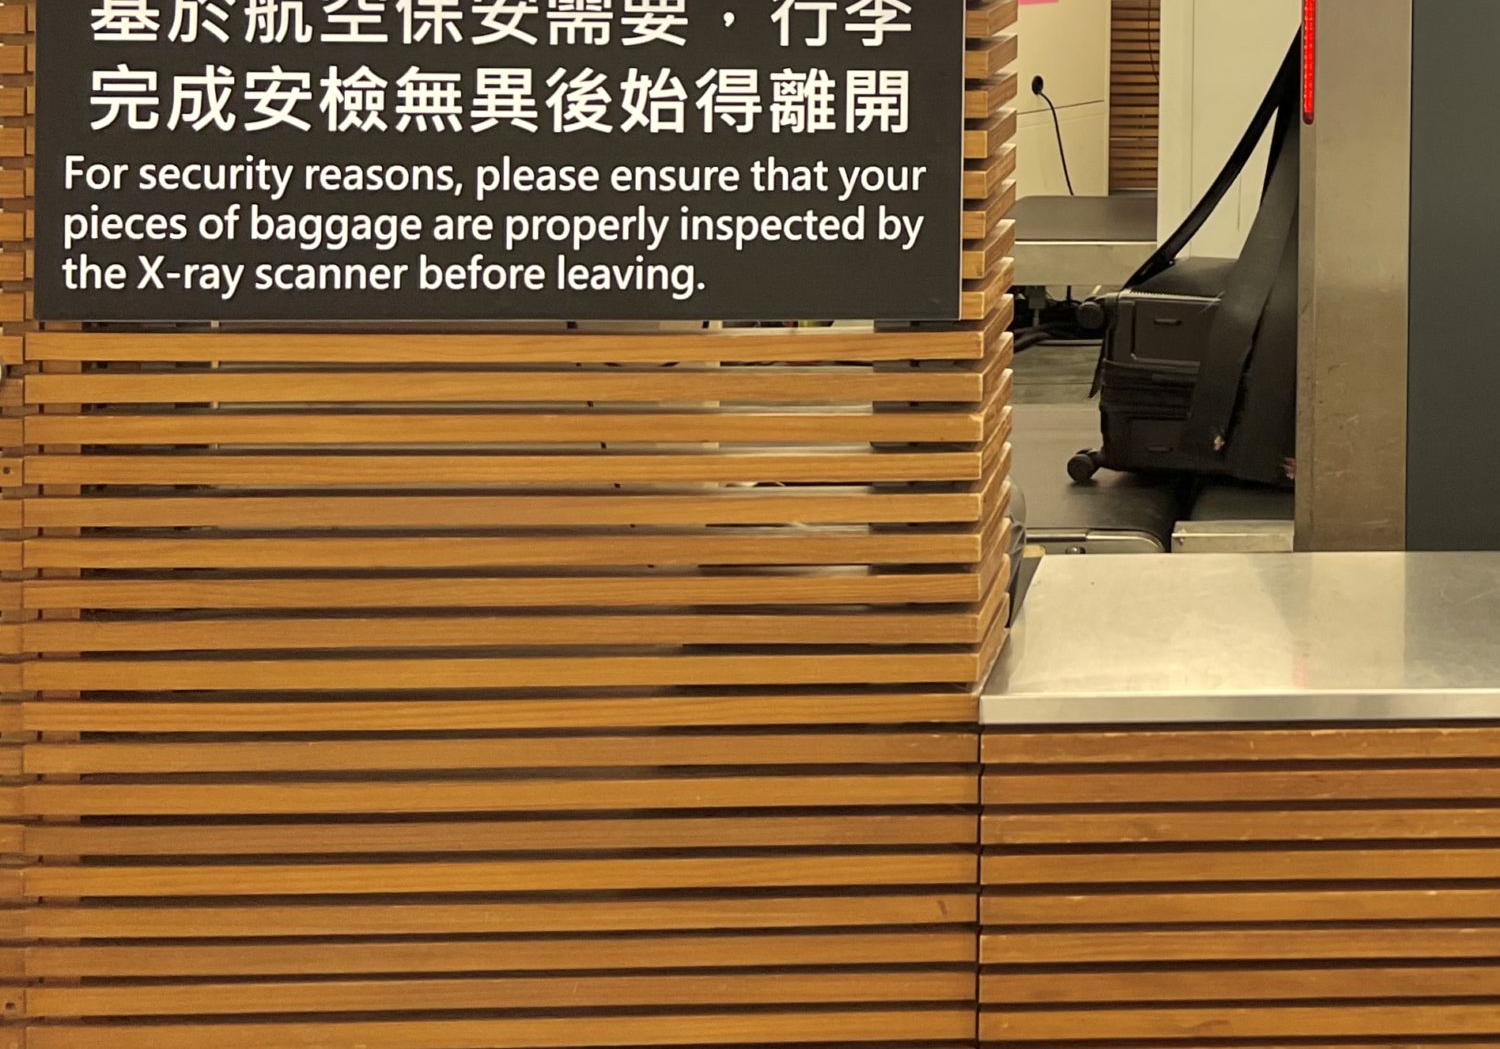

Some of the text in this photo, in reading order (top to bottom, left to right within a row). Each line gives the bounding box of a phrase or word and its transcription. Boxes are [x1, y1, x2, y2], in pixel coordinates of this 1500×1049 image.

[91, 64, 909, 133] 完成安檢無異後始得離開
[66, 155, 927, 201] For security reasons, please ensure that your
[64, 203, 925, 251] pieces of baggage are properly inspected by
[62, 253, 705, 301] the X-ray scanner before leaving.
